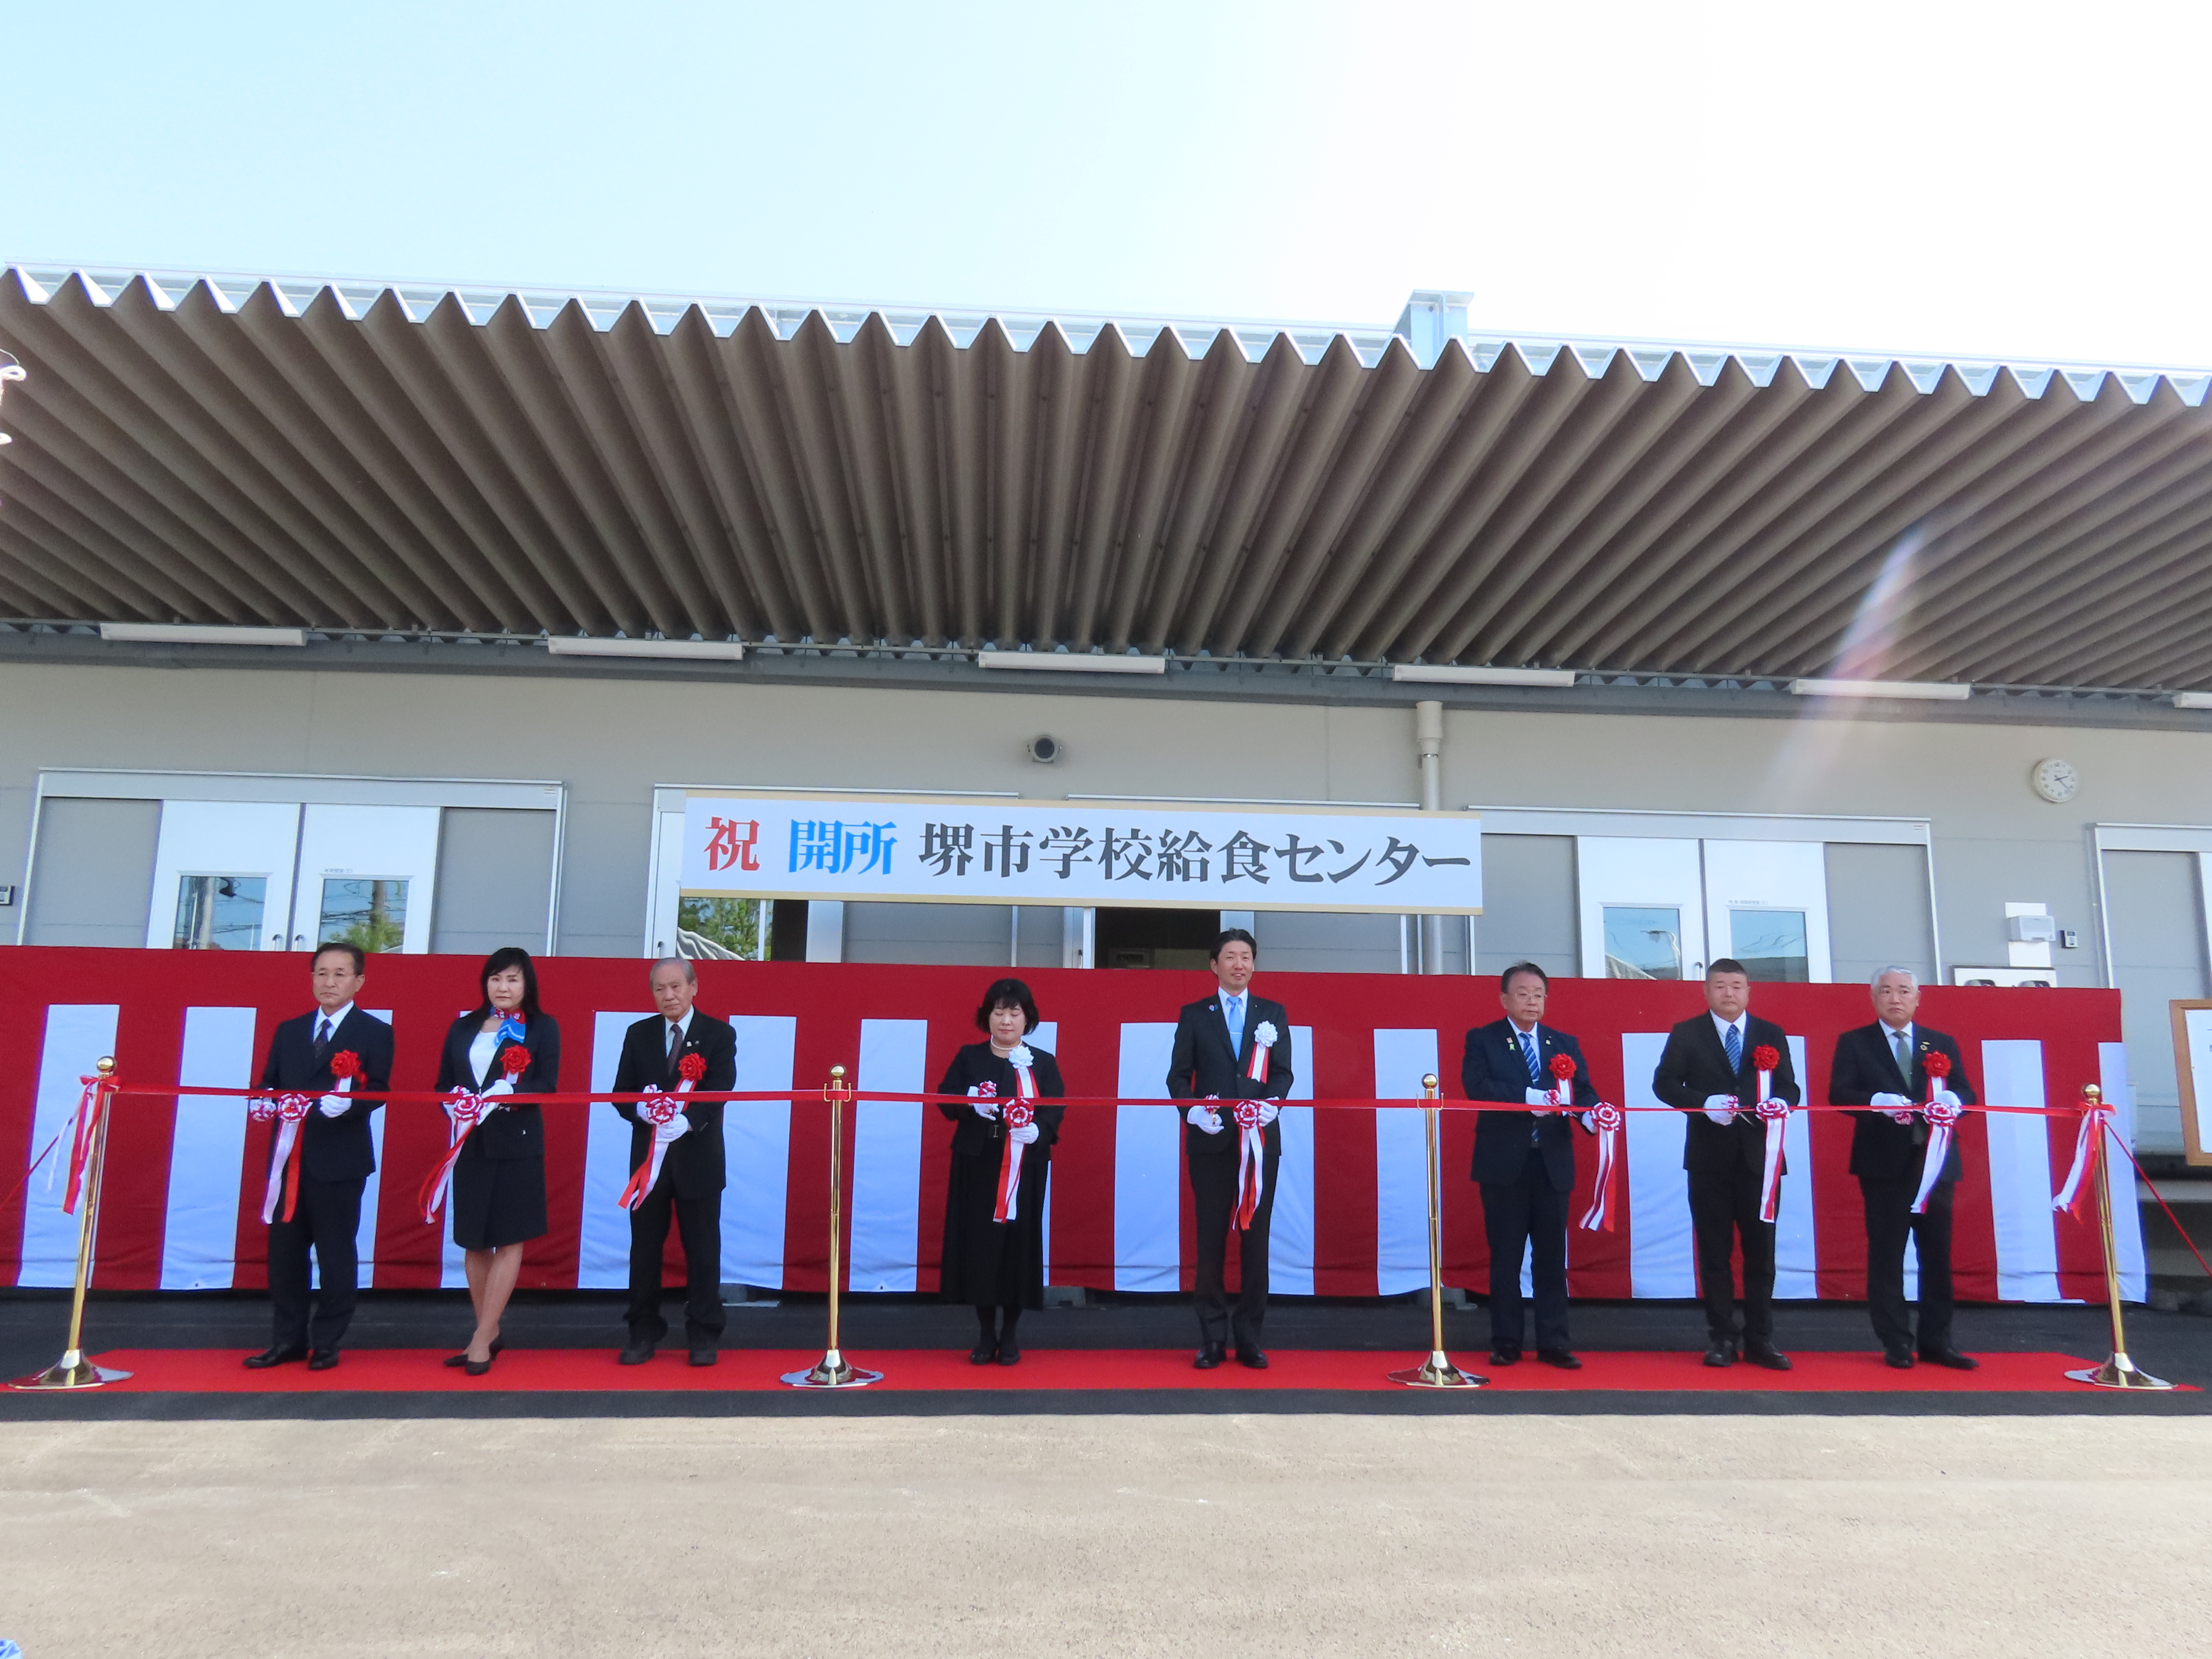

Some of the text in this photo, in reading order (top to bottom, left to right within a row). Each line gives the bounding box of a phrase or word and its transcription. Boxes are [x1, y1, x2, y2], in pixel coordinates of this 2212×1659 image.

[703, 817, 1471, 886] 祝 開所 堺市学校給食センター
